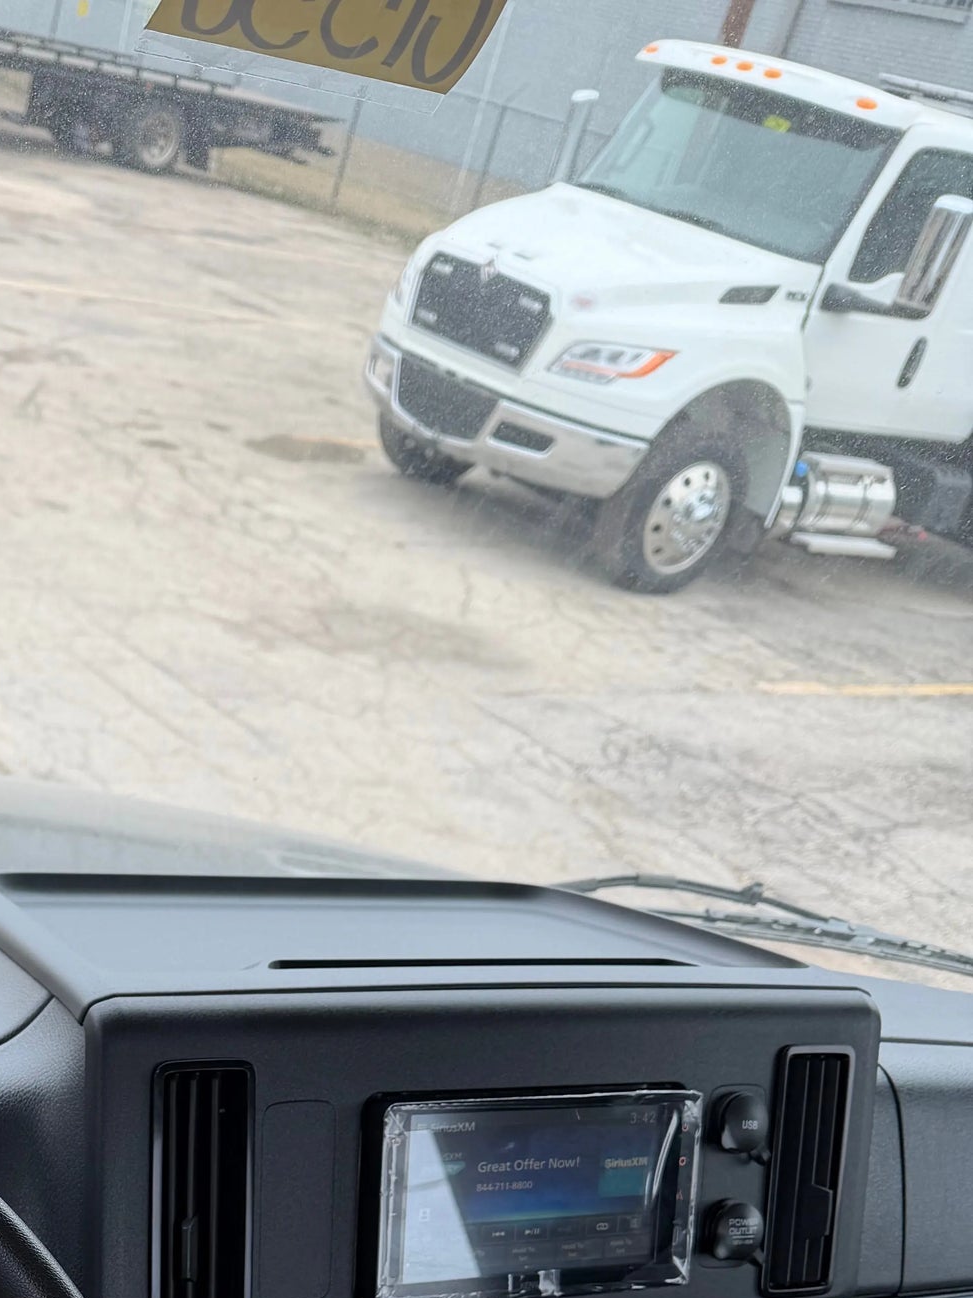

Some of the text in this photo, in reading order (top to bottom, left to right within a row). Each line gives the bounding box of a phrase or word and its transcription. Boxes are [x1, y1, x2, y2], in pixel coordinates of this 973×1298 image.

[742, 1120, 758, 1130] USB
[477, 1157, 580, 1173] Great Offer Now!
